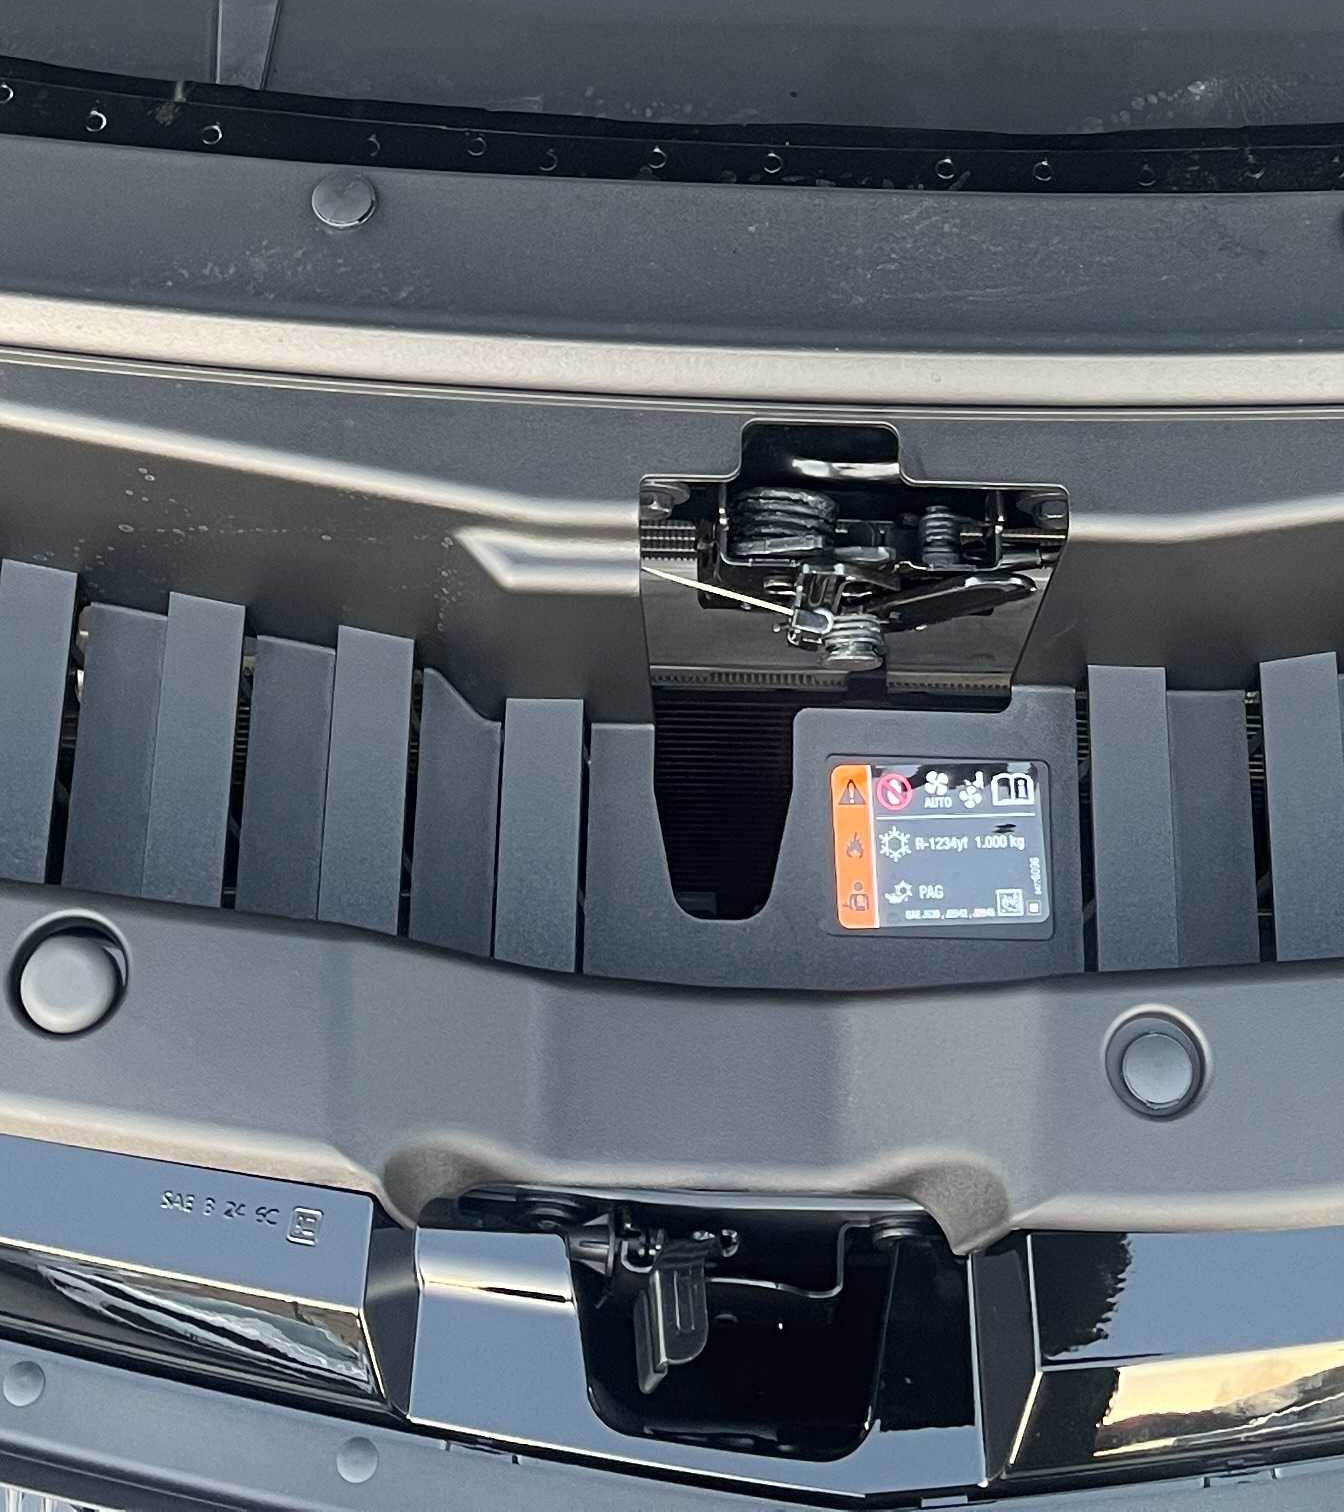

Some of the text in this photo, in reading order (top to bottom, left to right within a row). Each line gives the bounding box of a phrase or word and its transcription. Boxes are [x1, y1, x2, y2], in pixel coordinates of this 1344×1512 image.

[924, 796, 953, 809] AUTO
[914, 834, 1026, 852] R-1234yf 1.000 kg
[919, 884, 945, 899] PAG
[159, 1189, 195, 1214] SAE
